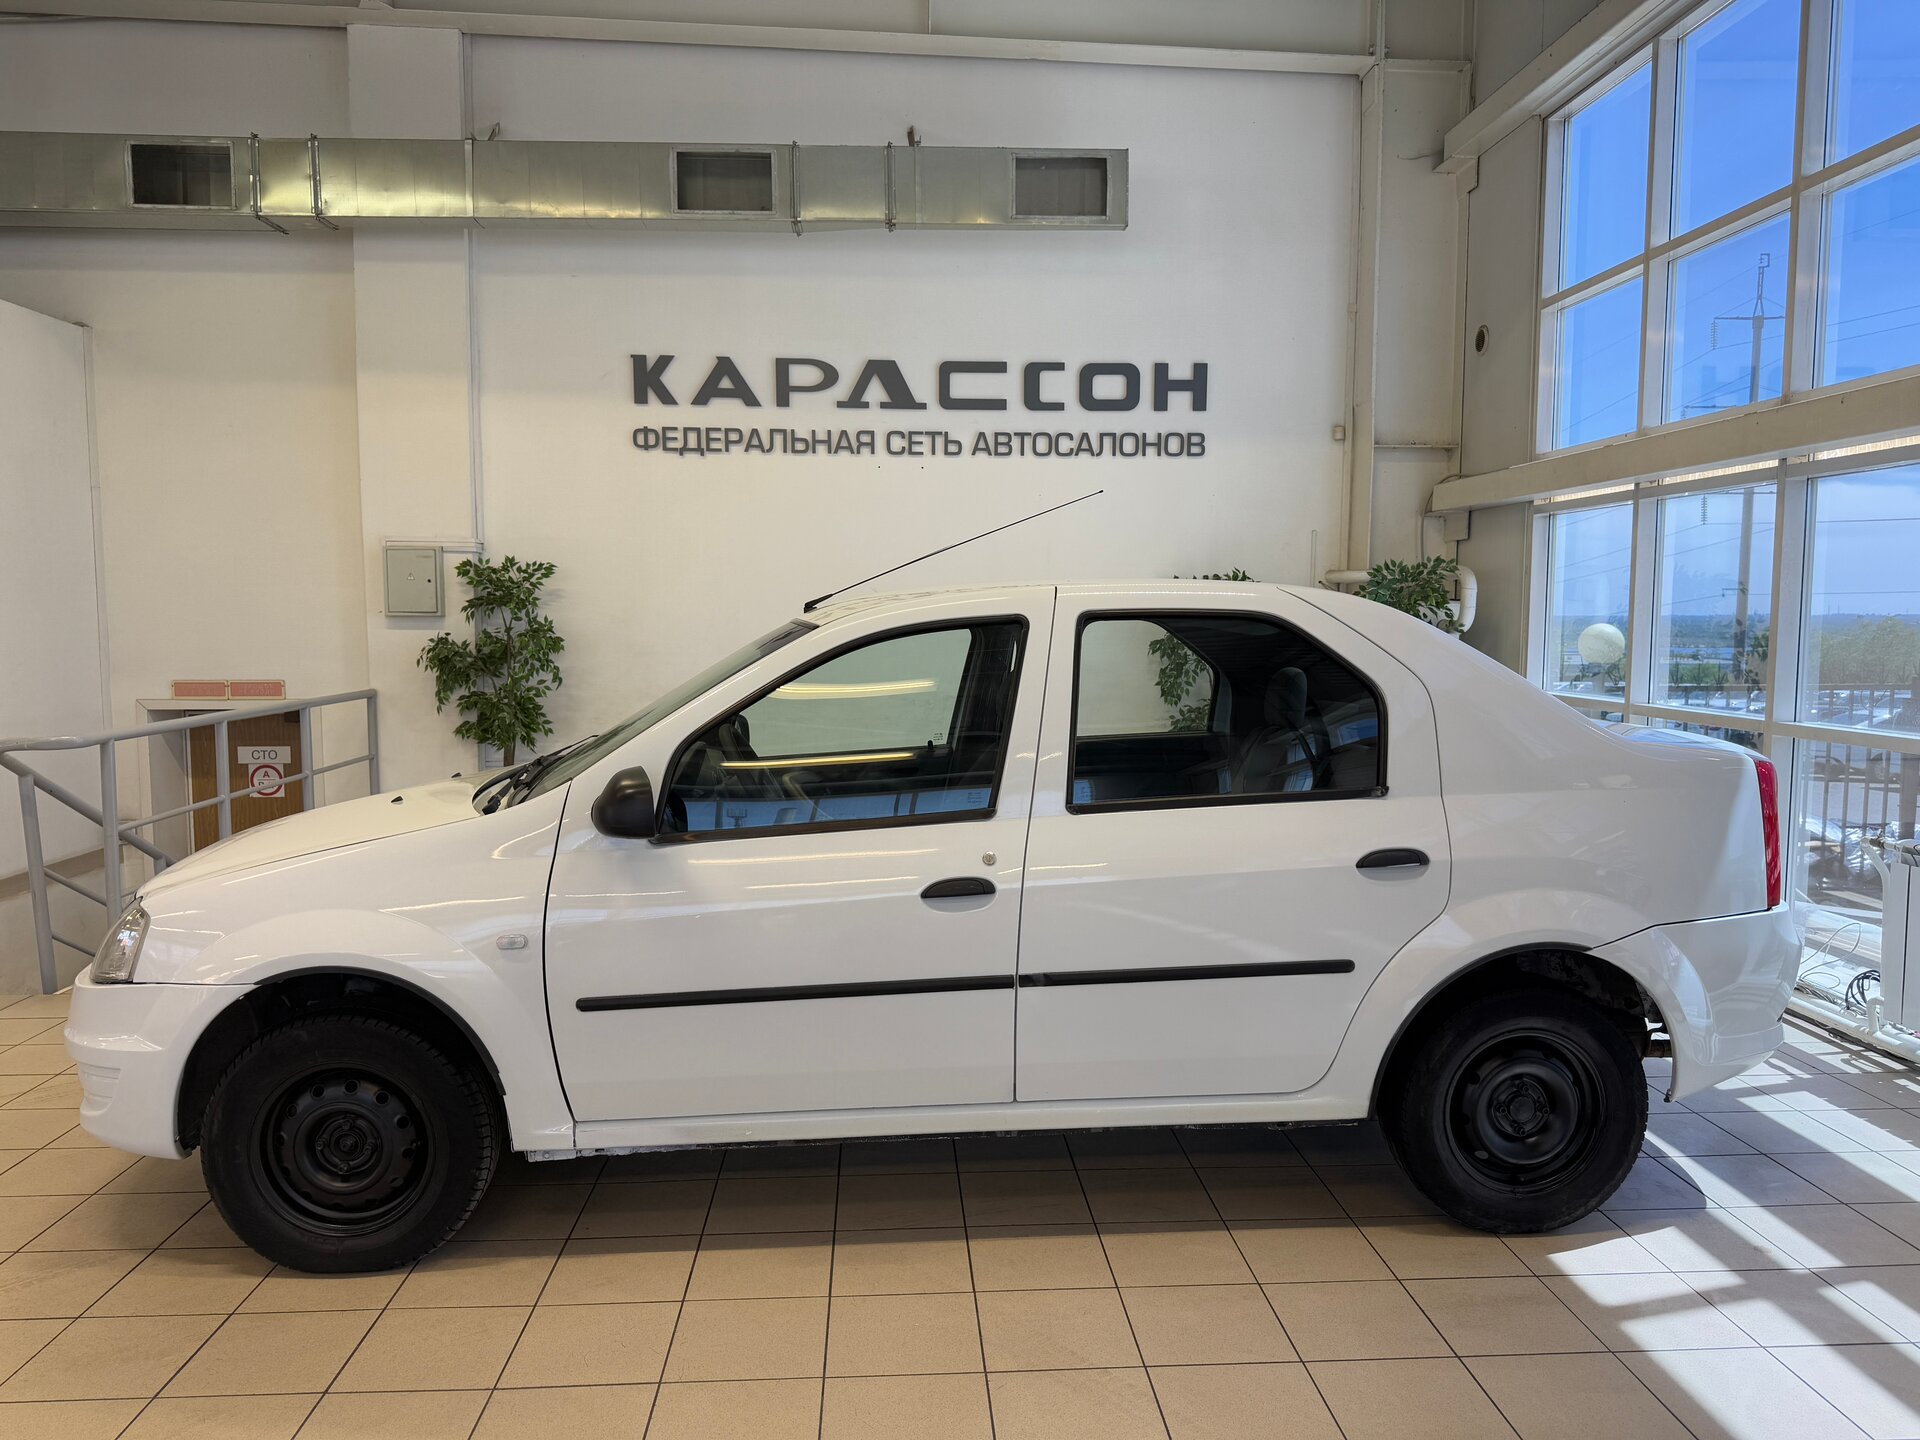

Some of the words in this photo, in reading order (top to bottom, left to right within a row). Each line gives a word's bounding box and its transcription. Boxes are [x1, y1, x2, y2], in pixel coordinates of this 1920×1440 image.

[632, 425, 875, 456] ФЕДЕРАЛЬНАЯ
[886, 430, 963, 456] СЕТЬ
[971, 431, 1206, 458] АВТОСАЛОНОВ
[251, 749, 278, 761] СТО
